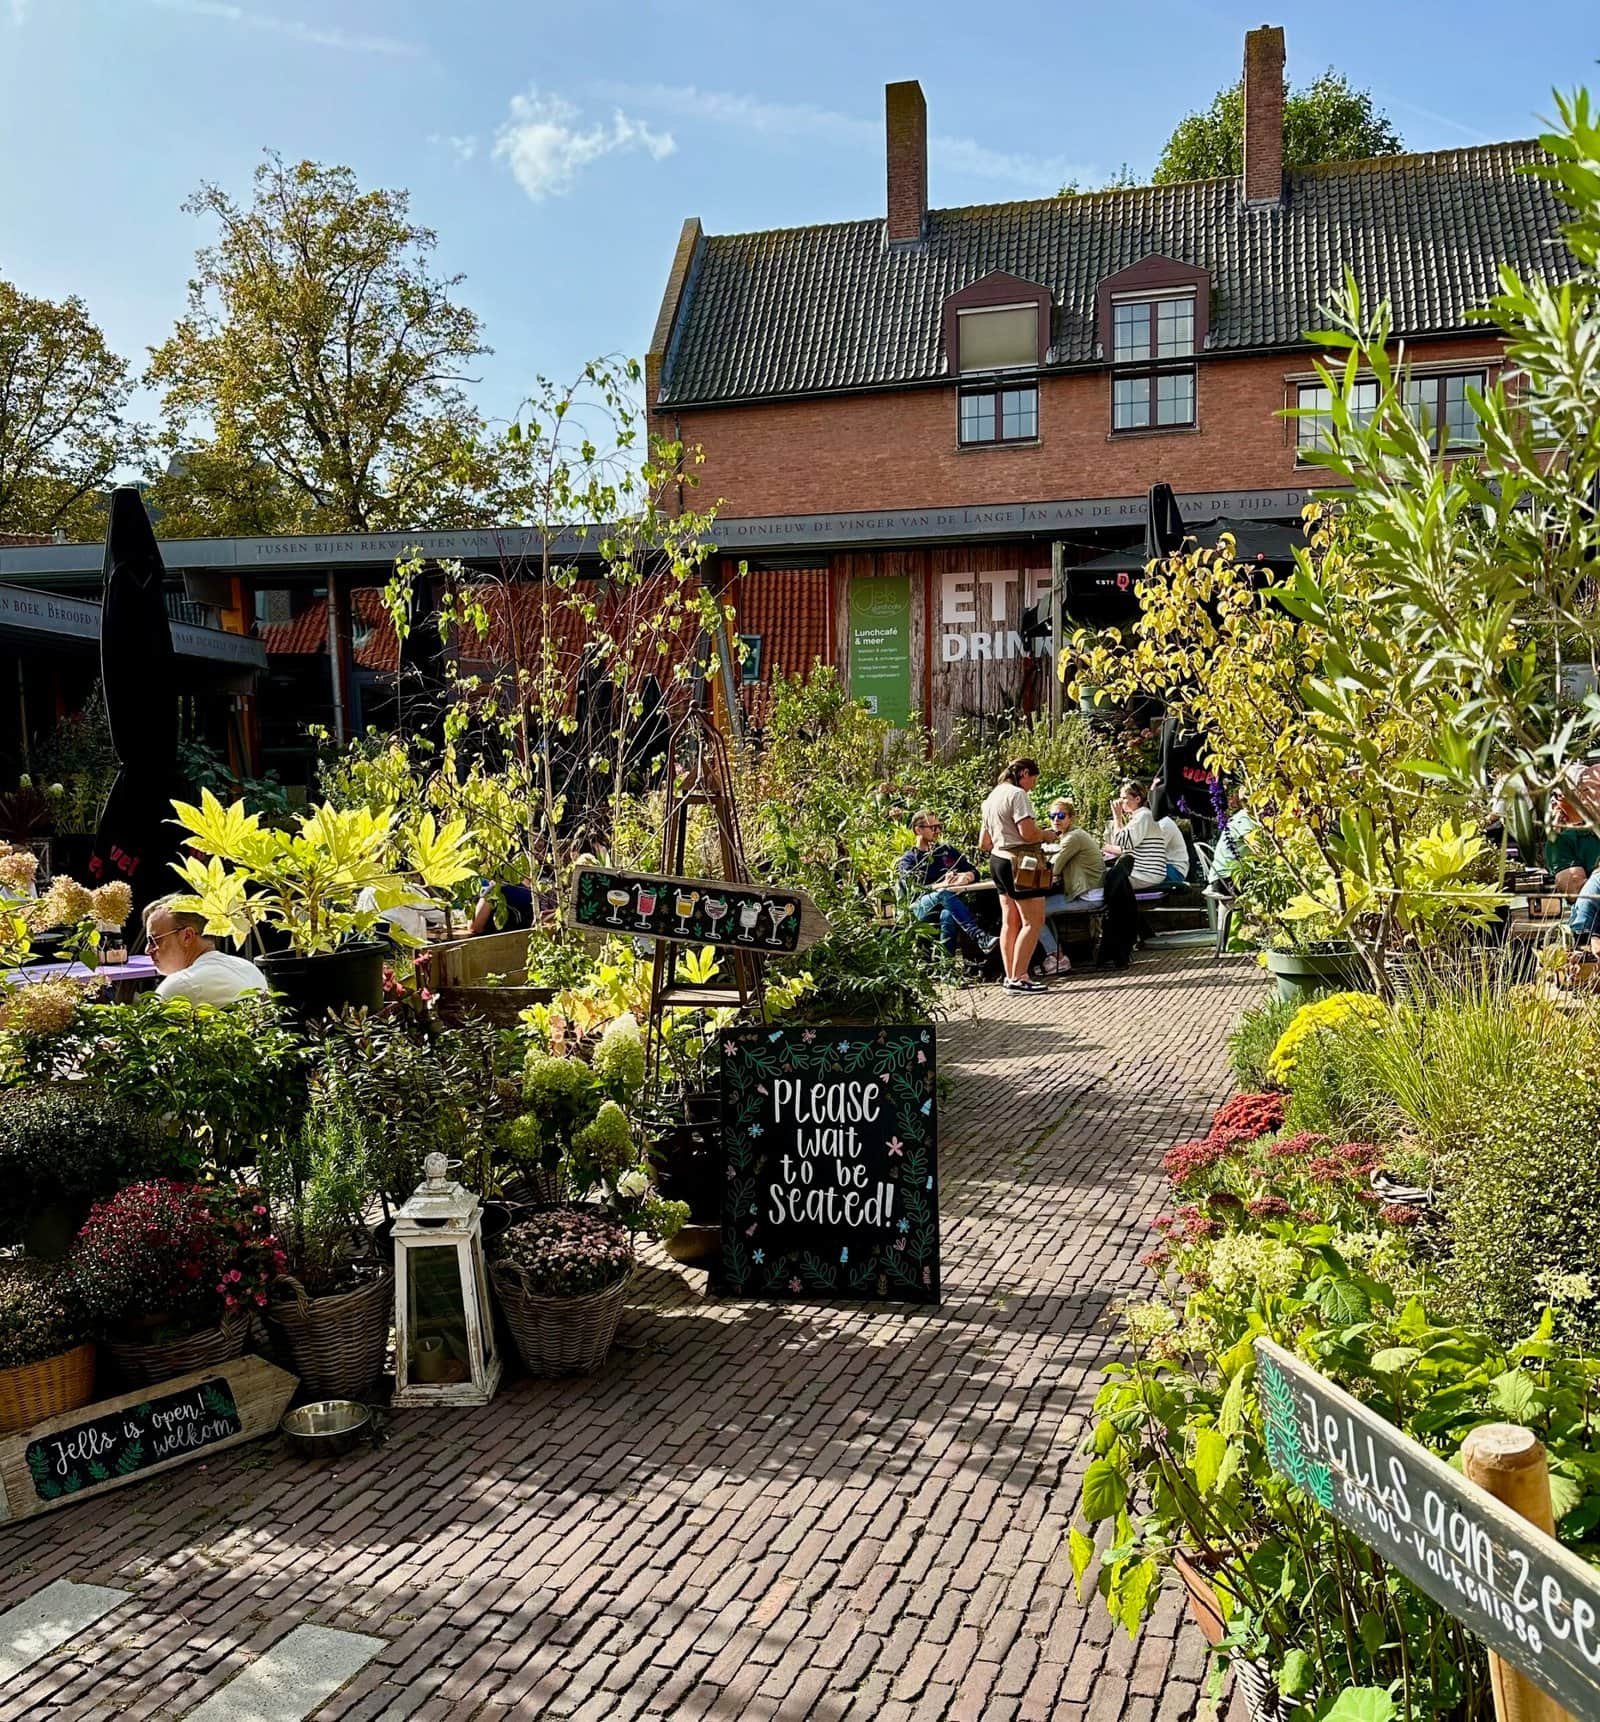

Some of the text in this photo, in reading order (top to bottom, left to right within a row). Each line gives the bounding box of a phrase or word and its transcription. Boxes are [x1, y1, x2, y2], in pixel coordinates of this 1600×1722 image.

[738, 523, 805, 536] OPNIEUW
[814, 521, 833, 532] DE
[840, 516, 895, 530] VINGER
[902, 515, 930, 527] VAN
[936, 514, 955, 526] DE
[1055, 506, 1085, 519] AAN
[1092, 504, 1112, 517] DE
[1211, 499, 1232, 510] DE
[255, 542, 308, 555] TUSSEN
[315, 541, 354, 553] RIJEN
[462, 535, 489, 547] VAN
[854, 637, 885, 646] & meer
[855, 626, 898, 637] Lunchcafé
[774, 1079, 880, 1124] Please
[797, 1124, 862, 1158] wait
[779, 1154, 869, 1188] to be
[768, 1181, 895, 1228] Seated!
[51, 1392, 206, 1475] Jells is open!
[153, 1418, 235, 1457] welkom
[1301, 1393, 1412, 1523] Jells
[1423, 1490, 1495, 1587] aan
